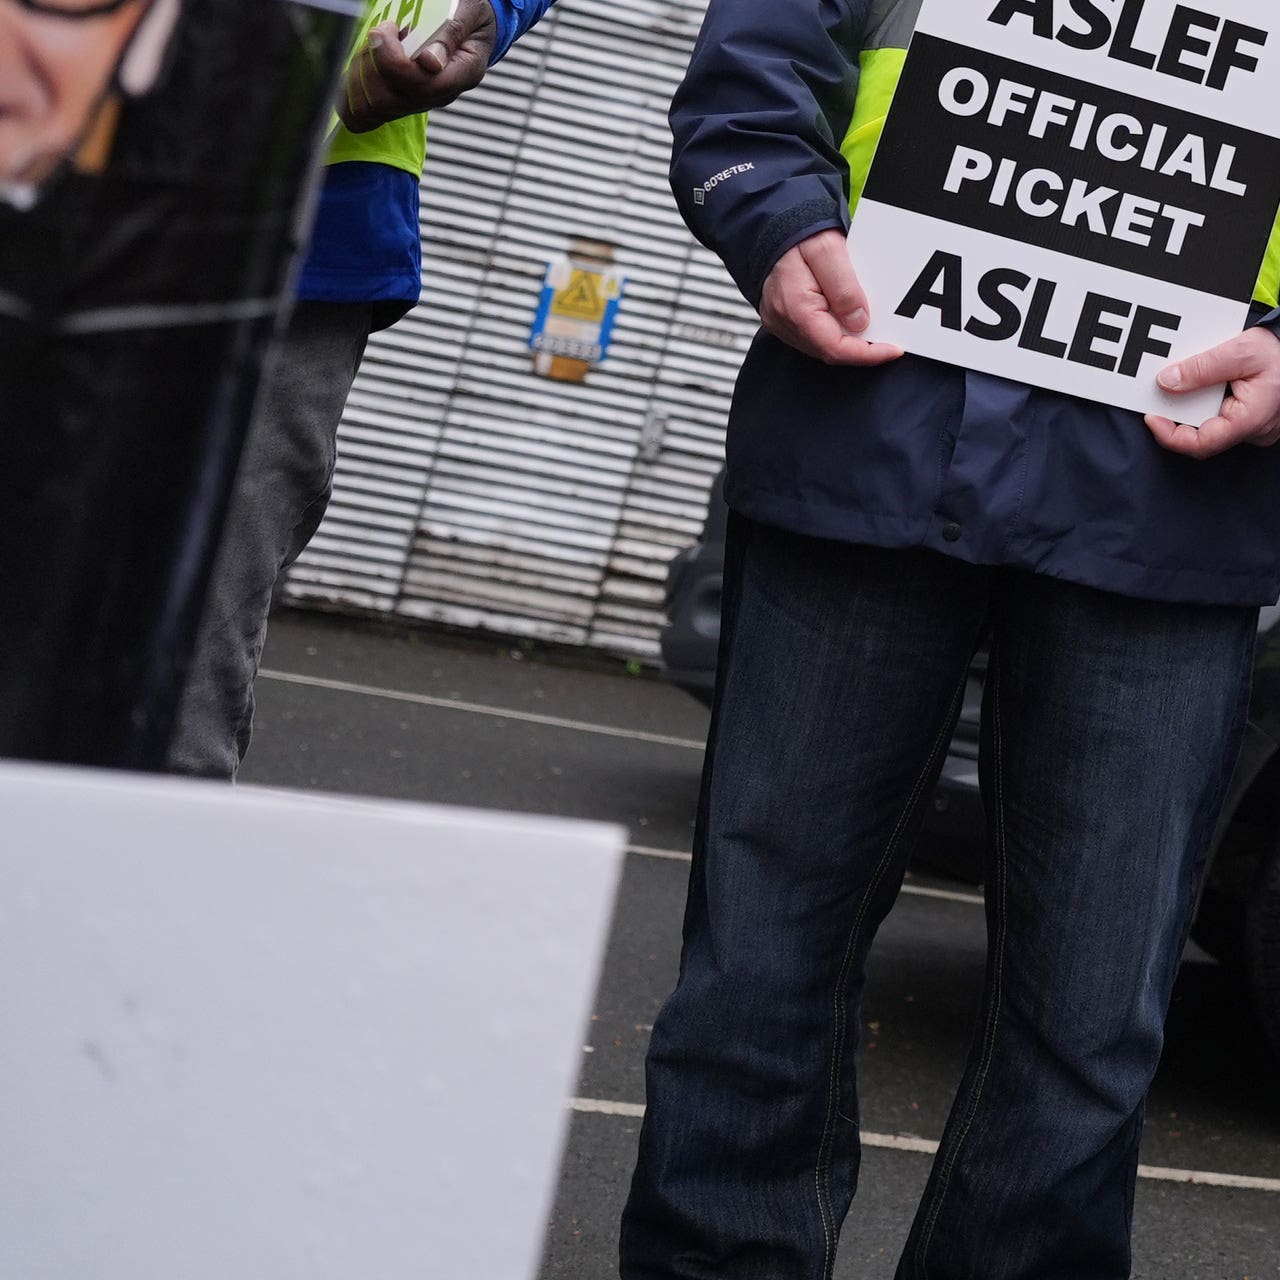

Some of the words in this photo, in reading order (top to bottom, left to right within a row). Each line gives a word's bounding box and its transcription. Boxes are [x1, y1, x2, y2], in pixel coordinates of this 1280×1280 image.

[703, 161, 755, 193] GORE-TEX
[937, 66, 1248, 197] OFFICIAL
[942, 145, 1206, 256] PICKET
[894, 249, 1181, 379] ASLEF
